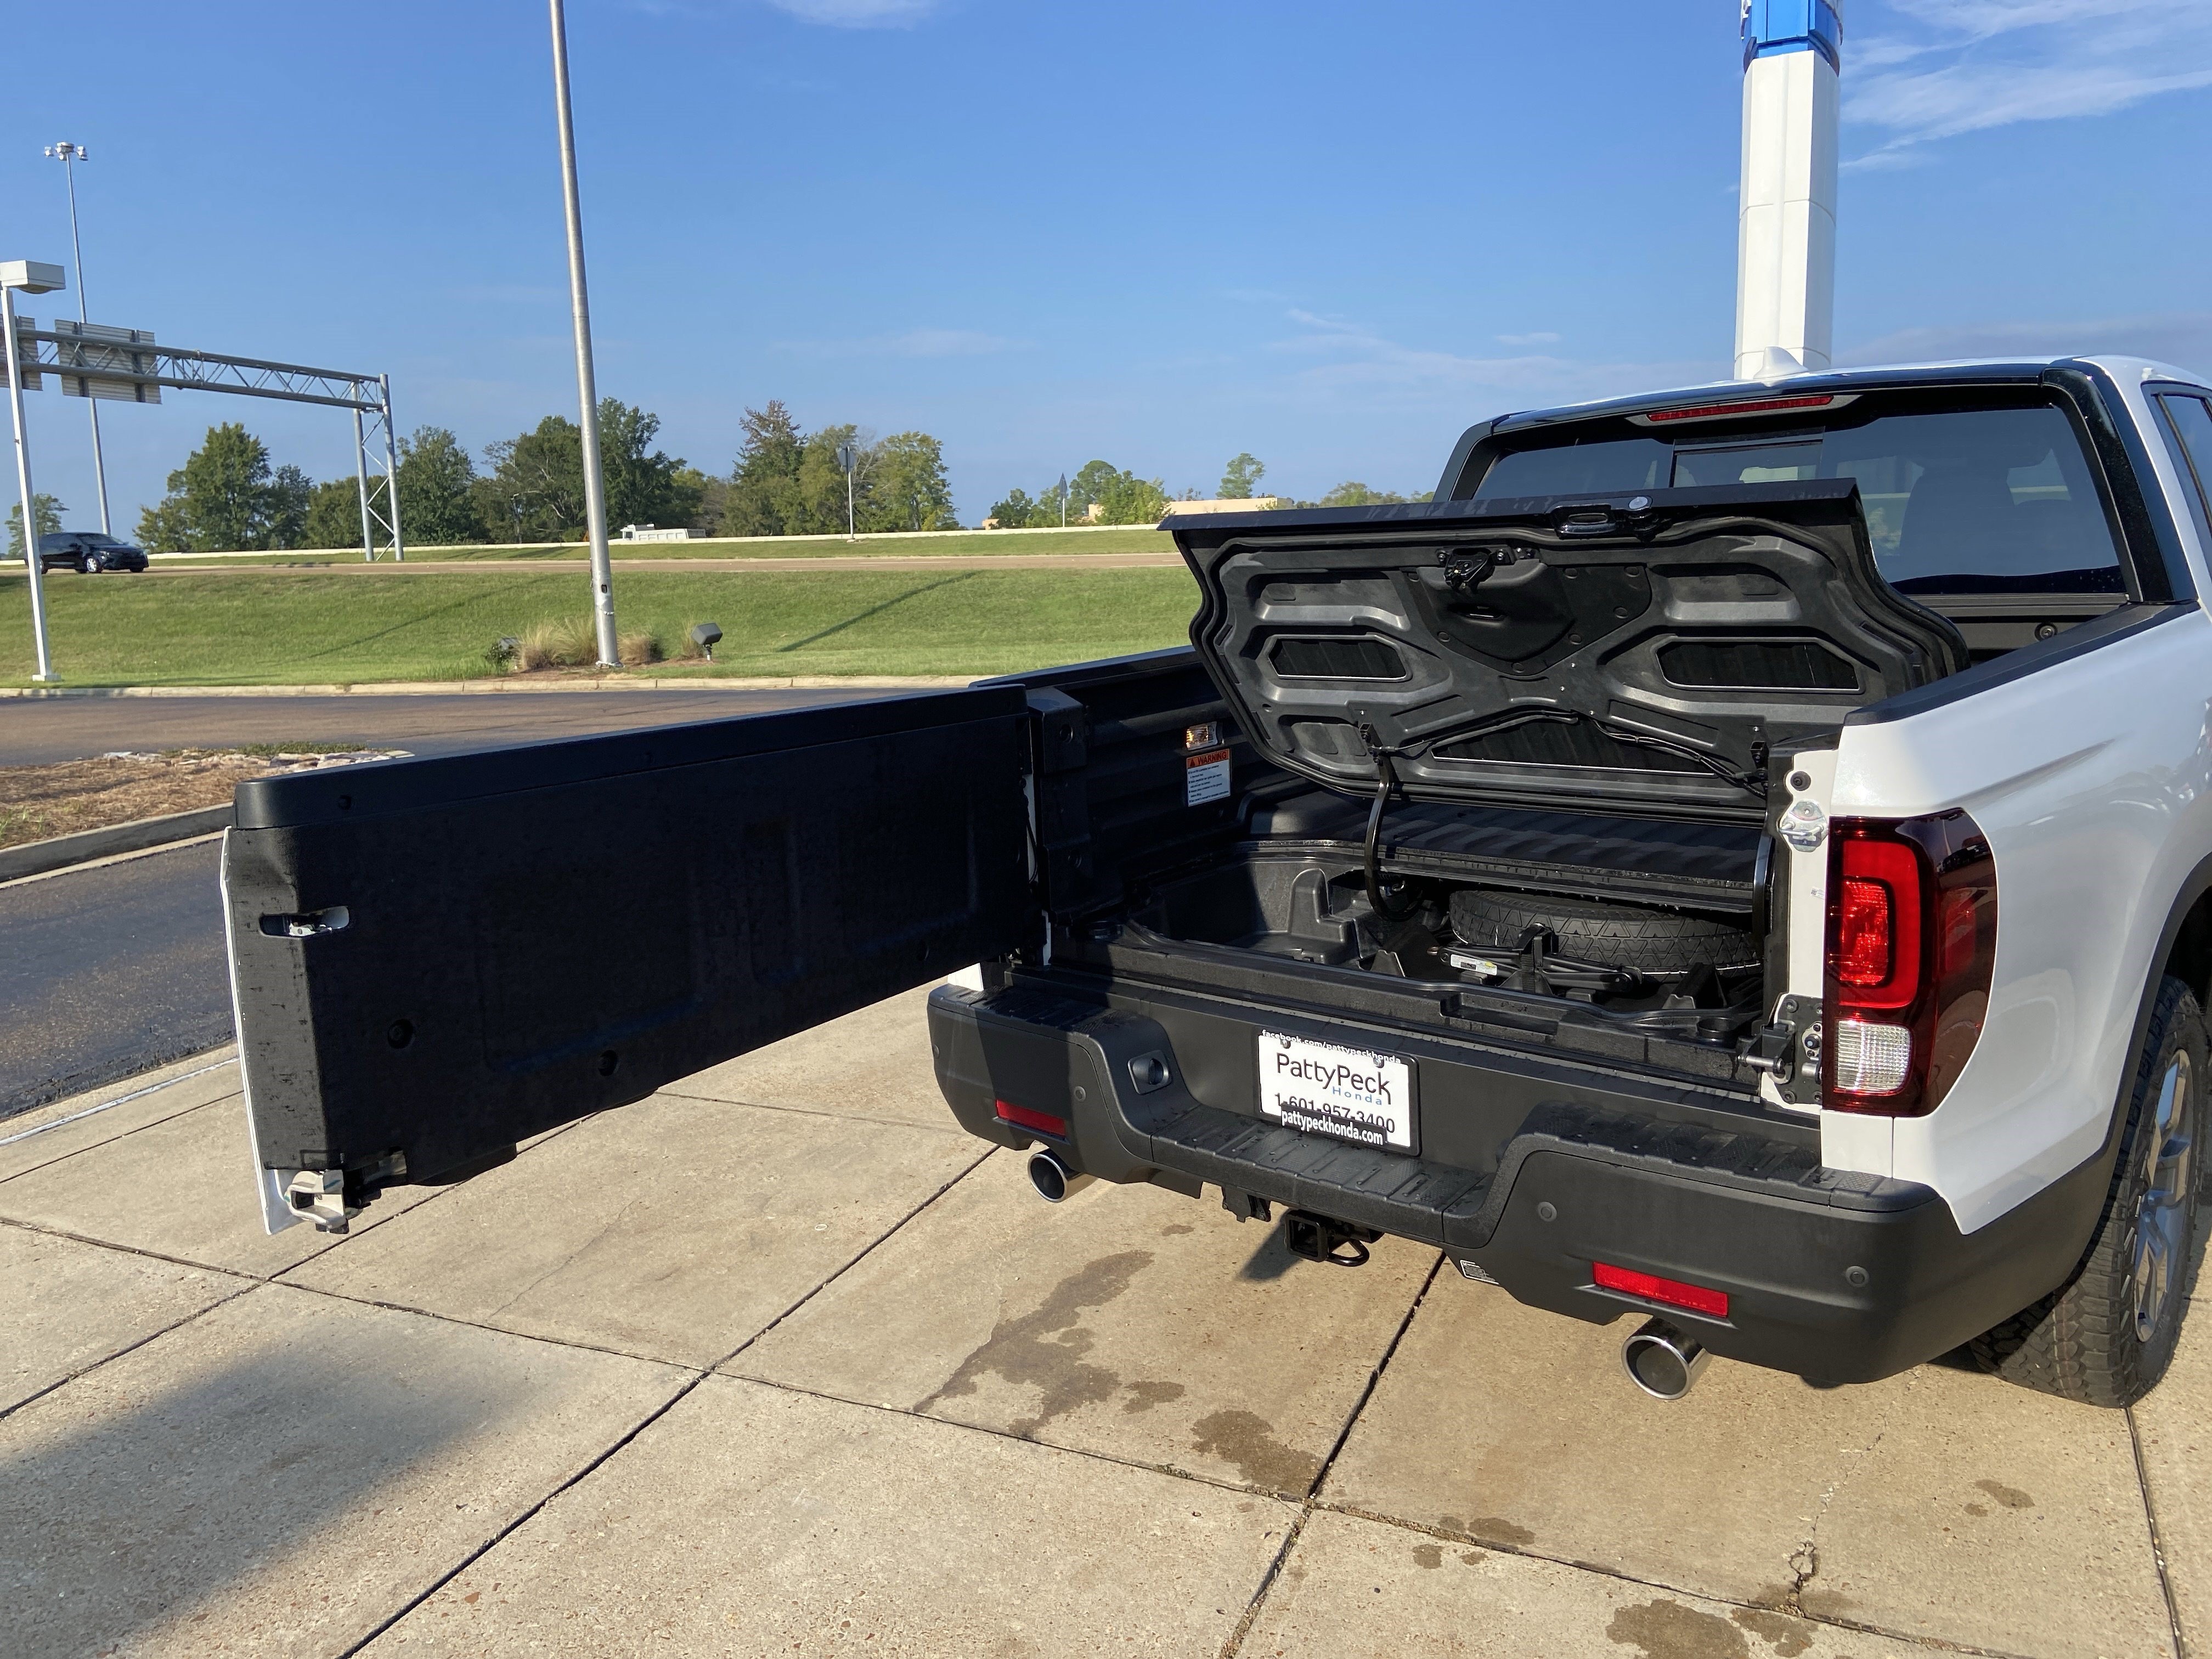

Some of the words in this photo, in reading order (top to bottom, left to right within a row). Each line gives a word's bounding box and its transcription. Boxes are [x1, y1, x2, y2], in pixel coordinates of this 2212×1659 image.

[1198, 751, 1227, 765] WARNING
[1262, 1029, 1401, 1064] facebook.com/pattypeckhonda
[1277, 1052, 1391, 1105] PattyPeck
[1333, 1086, 1382, 1105] Honda
[1274, 1093, 1395, 1133] 1-601-957-3400
[1282, 1110, 1383, 1145] pattypeckhonda.com
